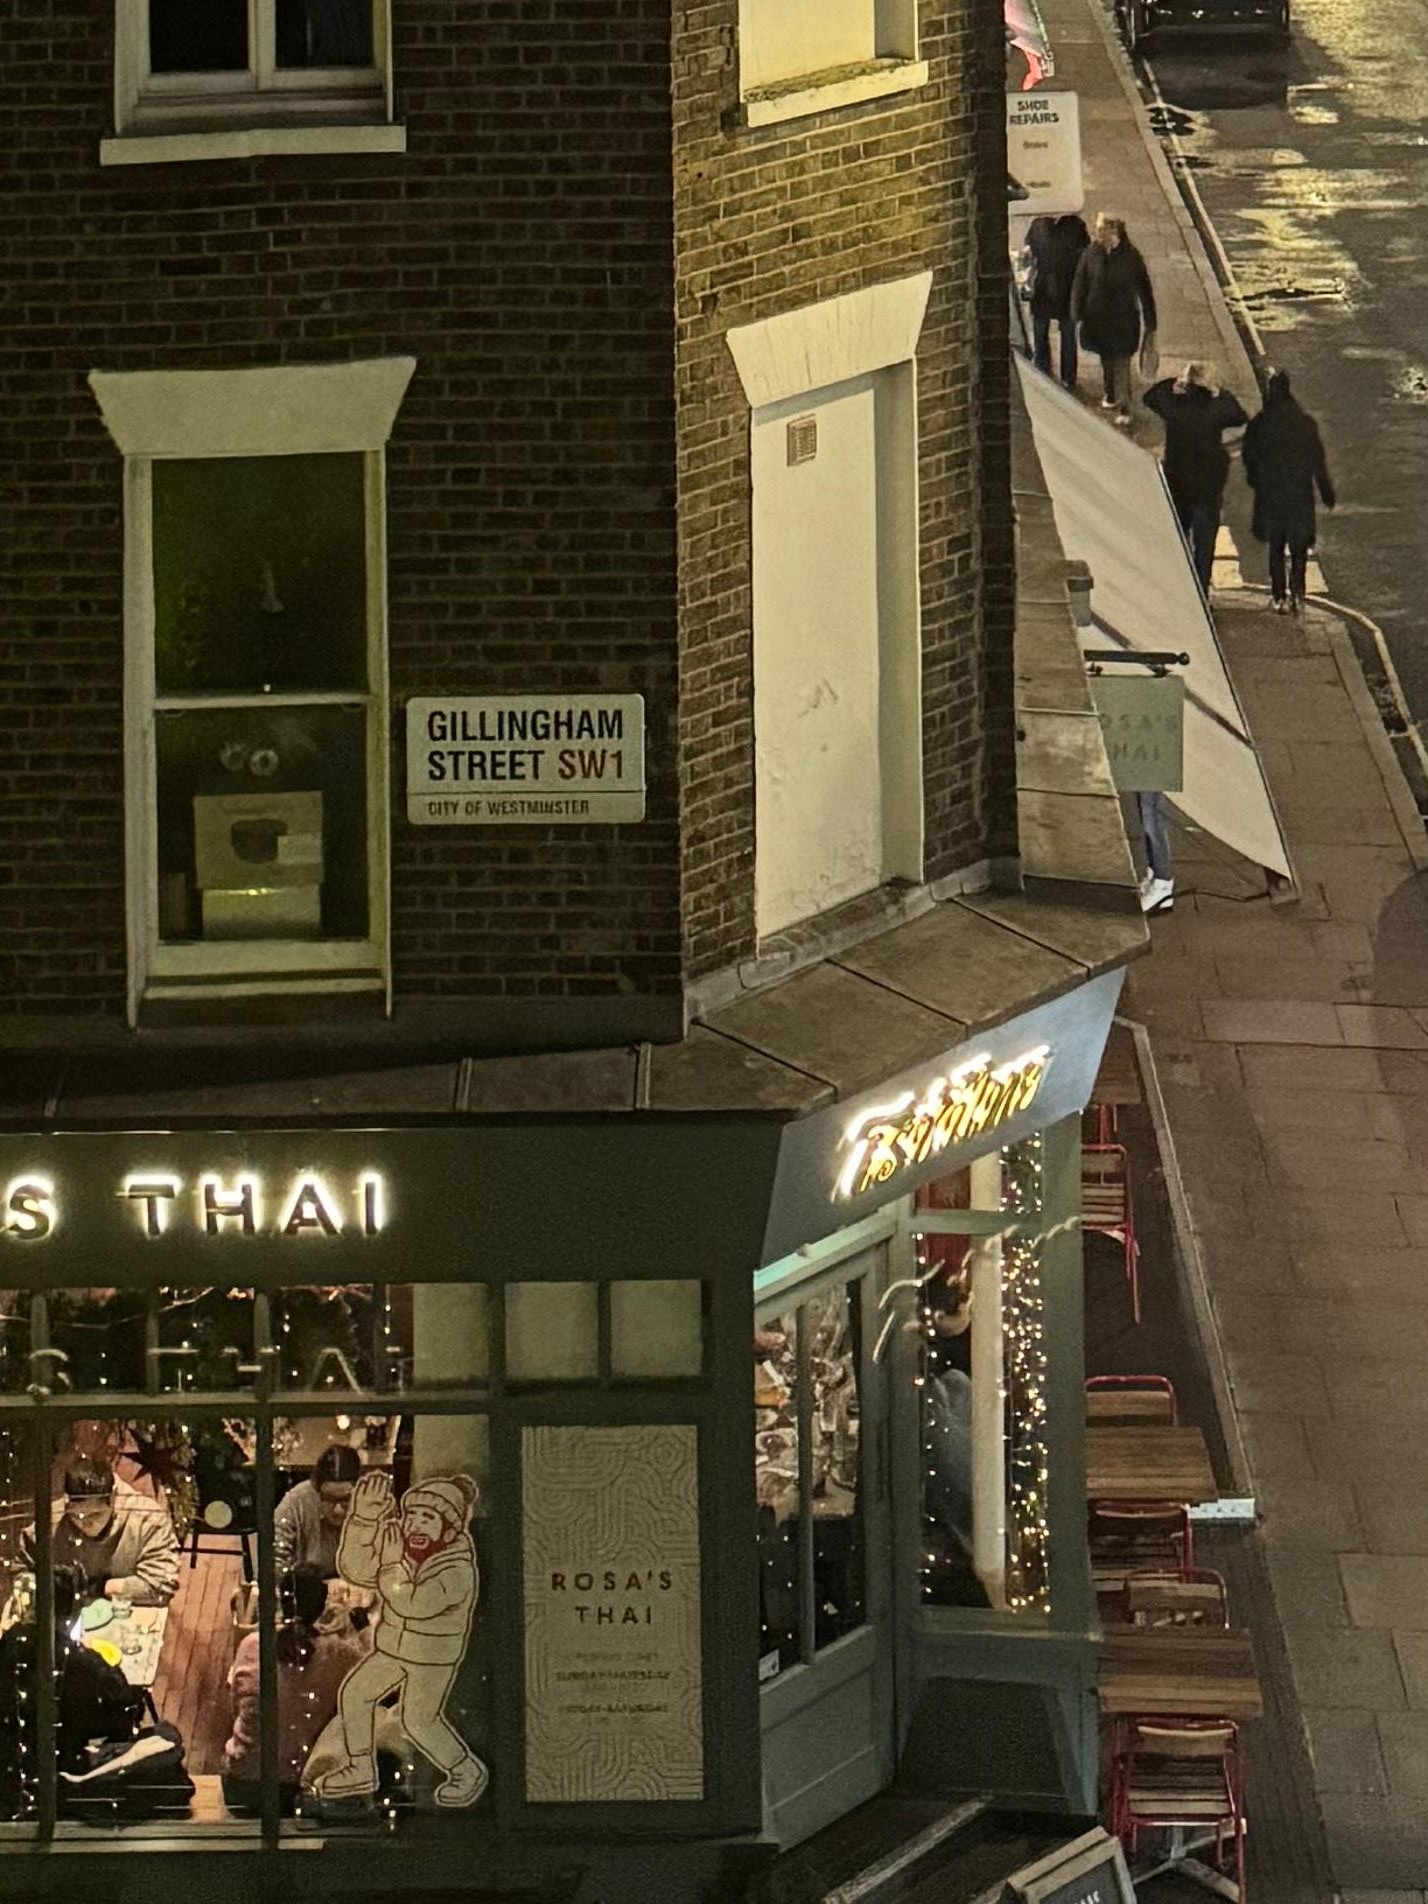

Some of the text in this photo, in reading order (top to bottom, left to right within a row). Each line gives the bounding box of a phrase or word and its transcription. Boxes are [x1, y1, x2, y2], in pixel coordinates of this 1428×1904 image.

[1018, 99, 1049, 111] SHOE
[1009, 112, 1059, 124] REPAIRS
[427, 709, 623, 742] GILLINGHAM
[1100, 712, 1178, 732] OSA'S
[428, 748, 623, 781] STREET SW1
[428, 799, 590, 816] CITY OF WESTMINSTER
[122, 1172, 383, 1240] THAI
[551, 1570, 673, 1592] ROSA'S
[574, 1605, 652, 1626] THAI
